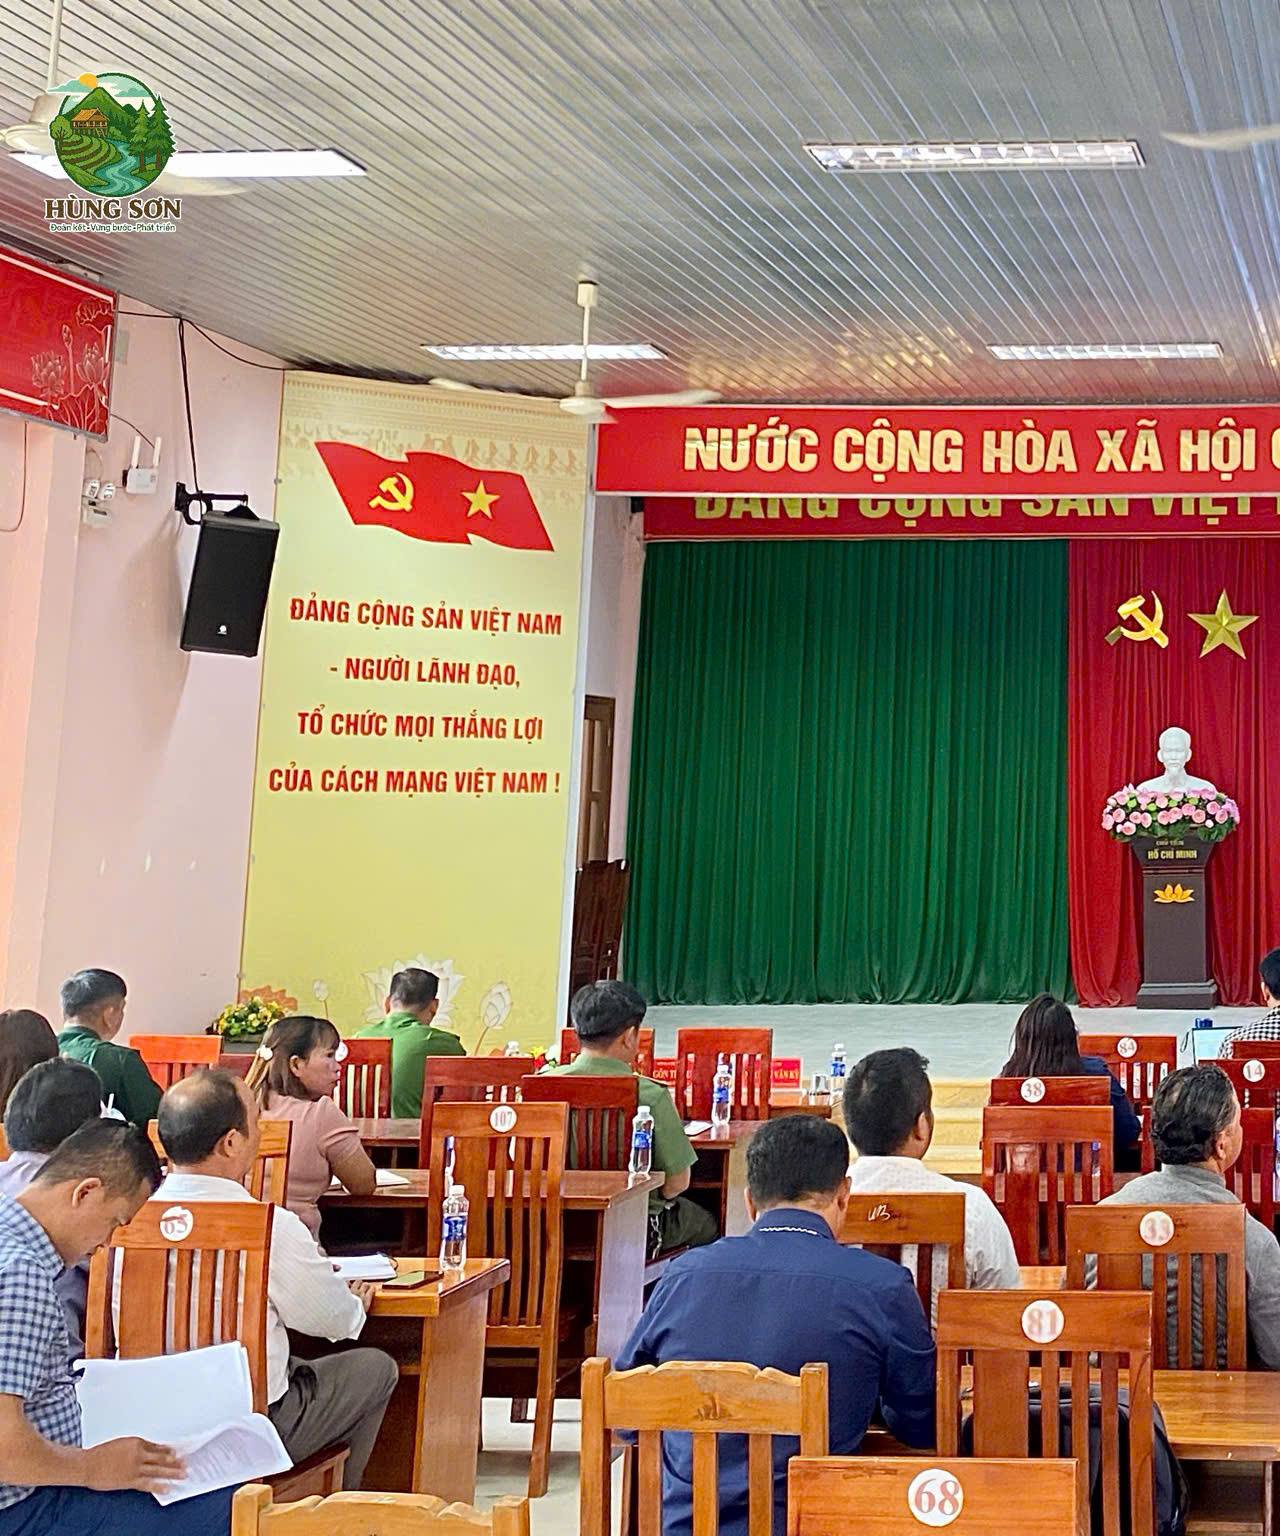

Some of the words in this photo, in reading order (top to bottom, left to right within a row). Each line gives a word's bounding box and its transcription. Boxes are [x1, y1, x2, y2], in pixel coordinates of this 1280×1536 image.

[684, 416, 818, 472] NƯỚC
[833, 417, 964, 482] CỘNG
[983, 418, 1077, 473] HÒA
[1095, 418, 1164, 473] XÃ
[1179, 417, 1256, 481] HỘI
[290, 592, 350, 623] ĐẢNG
[357, 600, 414, 630] CỘNG
[422, 601, 463, 630] SẢN
[470, 606, 511, 636] VIỆT
[517, 613, 562, 635] NAM
[344, 655, 410, 682] NGƯỜI
[417, 657, 470, 684] LÃNH
[476, 664, 520, 690] ĐẠO,
[298, 704, 324, 735] TỔ
[331, 709, 387, 737] CHỨC
[395, 715, 434, 742] MỌI
[441, 709, 507, 740] THẮNG
[514, 716, 543, 744] LỢI
[268, 761, 313, 792] CỦA
[321, 764, 378, 793] CÁCH
[386, 771, 448, 798] MẠNG
[455, 767, 496, 798] VIỆT
[502, 772, 547, 793] NAM
[1246, 1064, 1263, 1079] 14
[495, 1111, 513, 1127] 107
[1027, 1308, 1058, 1335] 81
[914, 1478, 959, 1515] 68
